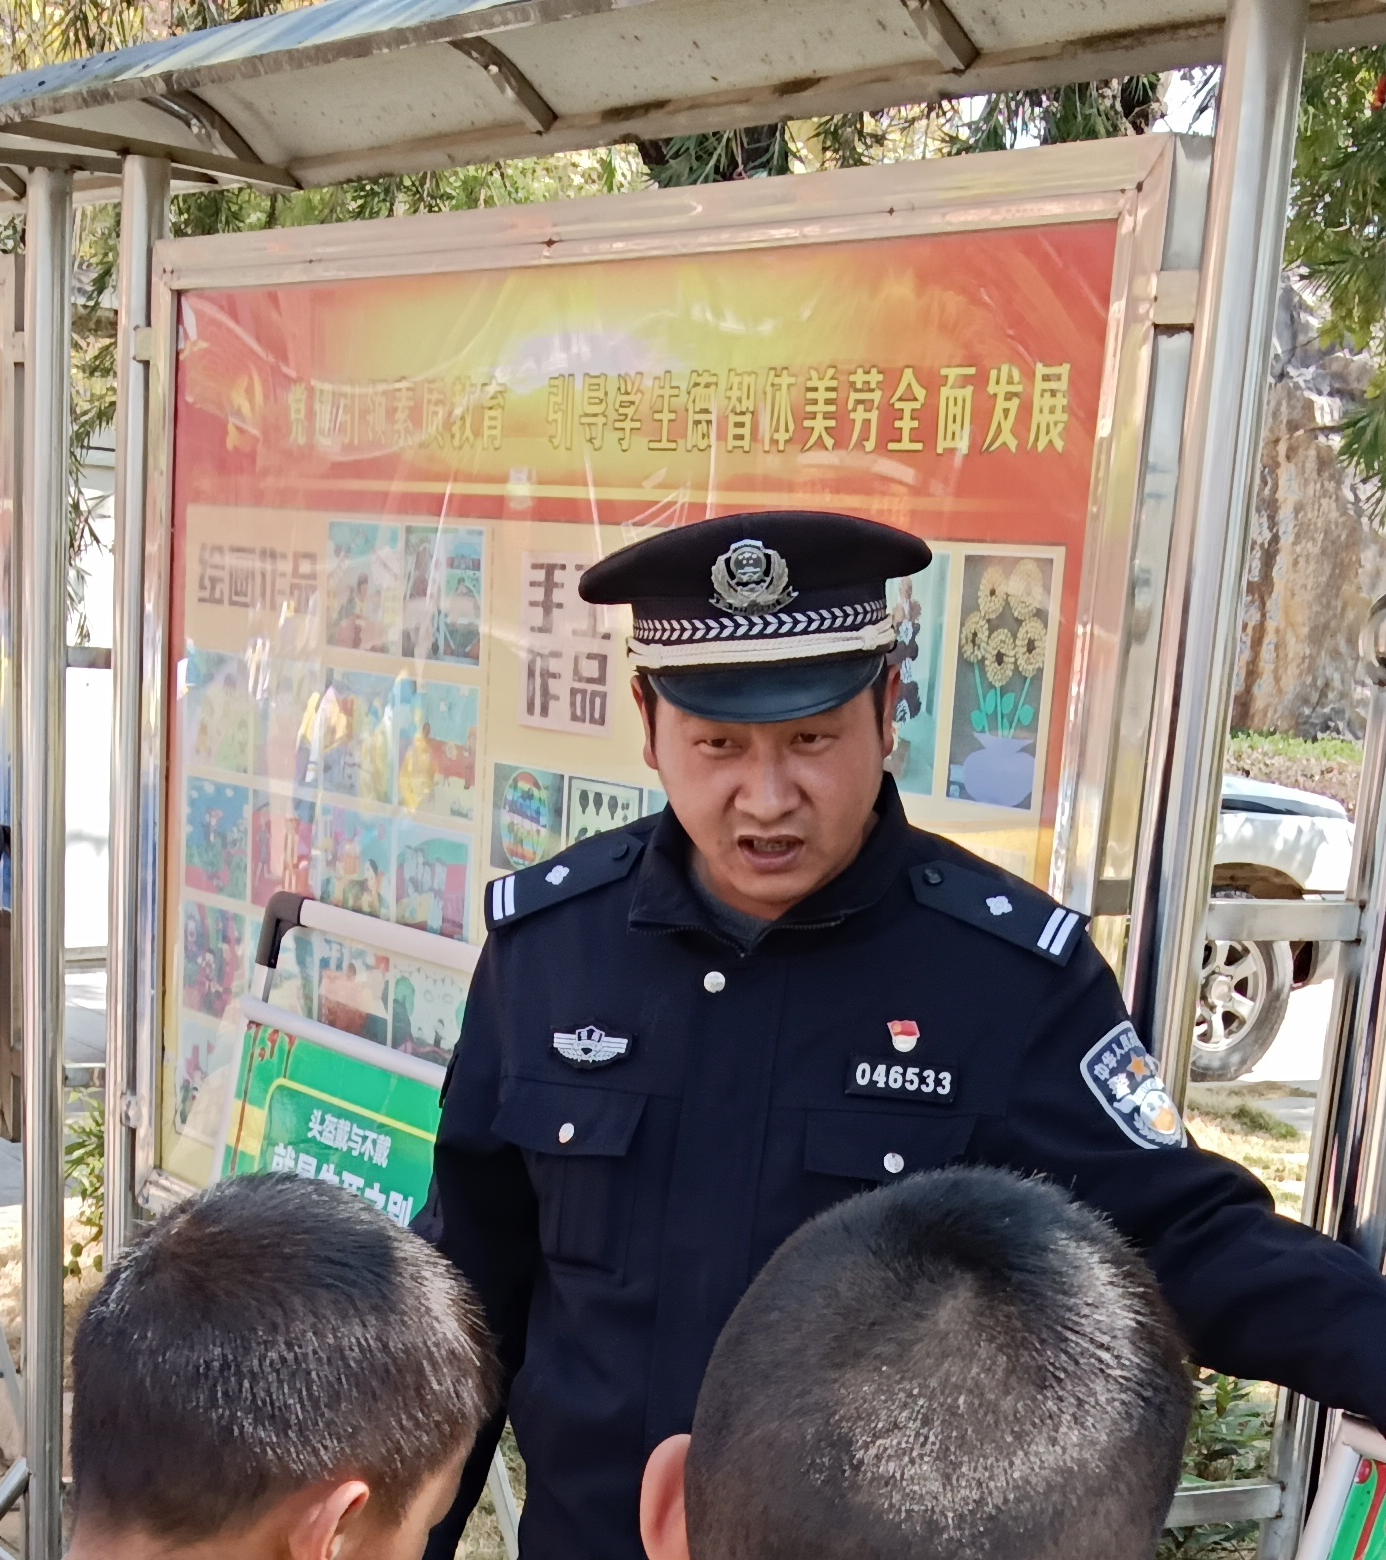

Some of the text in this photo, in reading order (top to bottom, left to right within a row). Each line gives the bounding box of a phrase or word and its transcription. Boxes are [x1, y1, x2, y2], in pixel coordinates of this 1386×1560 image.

[546, 361, 1071, 455] 引导学生德智体美劳全面发展
[526, 650, 608, 728] 作品
[855, 1061, 952, 1095] 046533
[307, 1108, 392, 1168] 头盔戴与不戴
